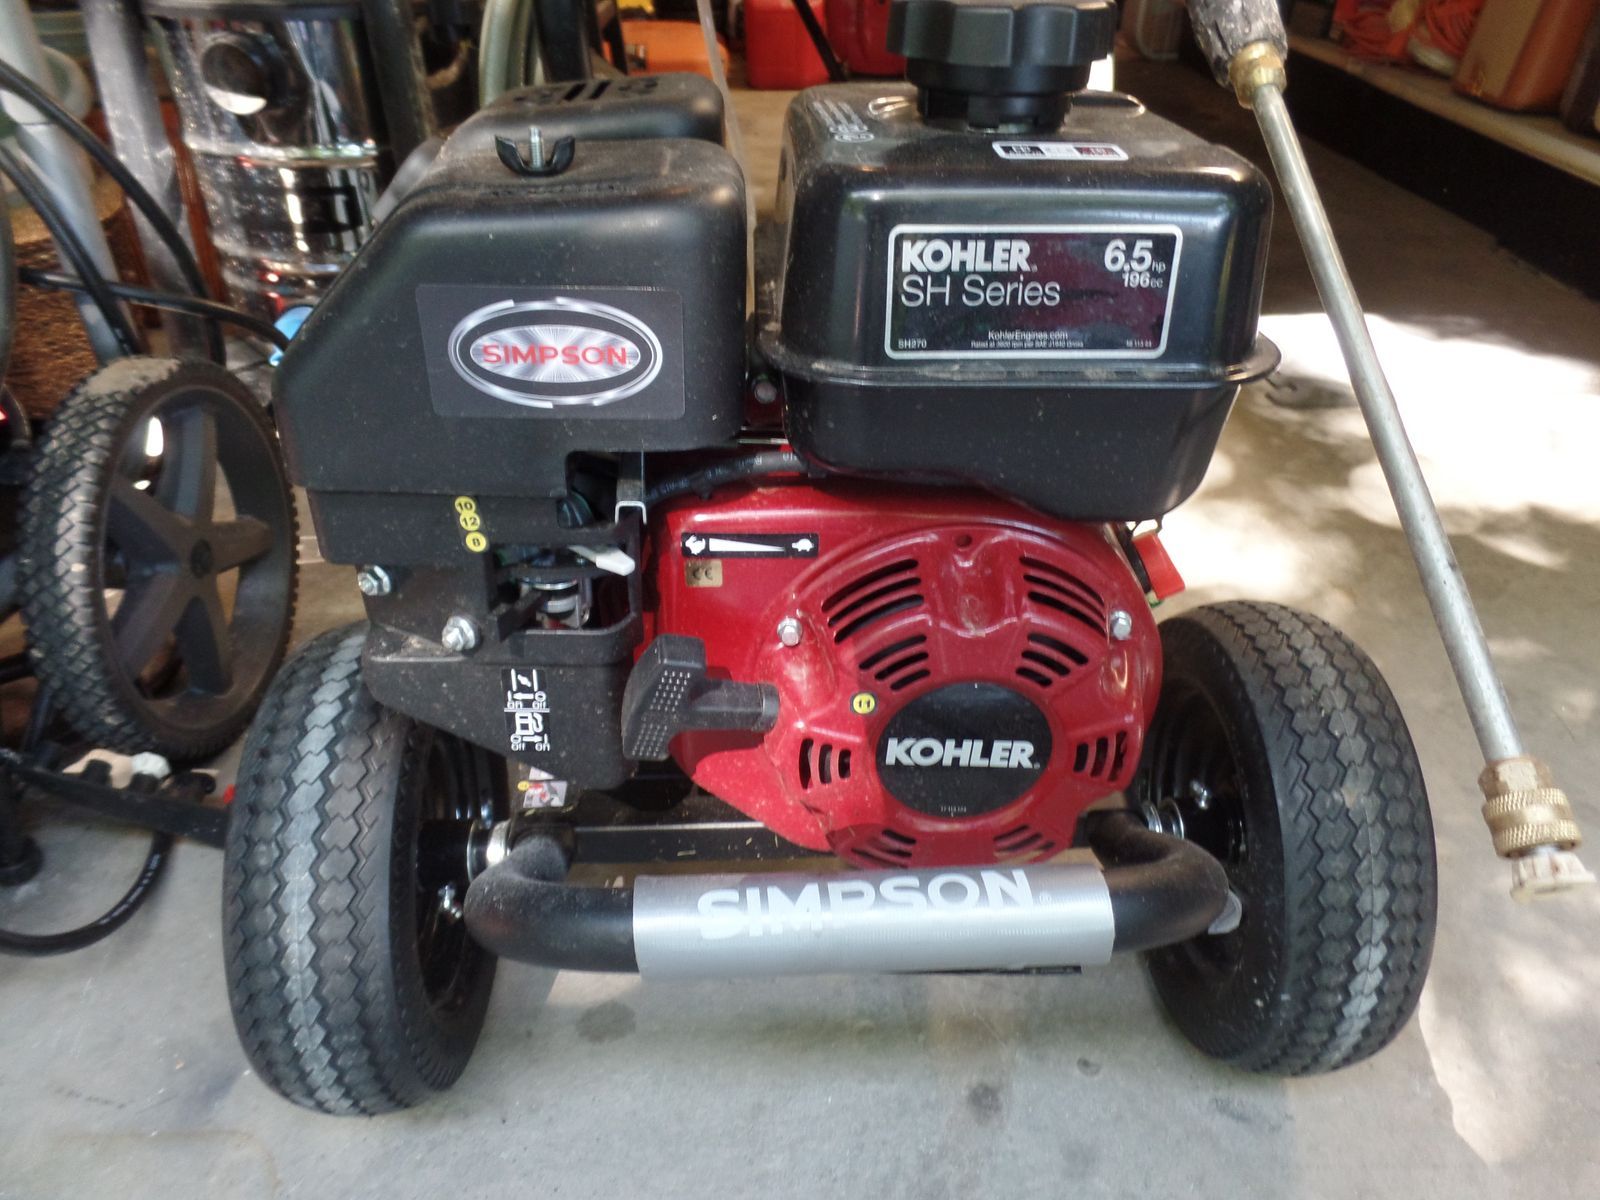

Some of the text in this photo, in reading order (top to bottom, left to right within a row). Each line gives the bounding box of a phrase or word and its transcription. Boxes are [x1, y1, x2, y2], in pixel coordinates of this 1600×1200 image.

[901, 238, 1031, 273] KOHLER
[901, 273, 1061, 307] SH Series
[482, 344, 627, 366] SIMPSON
[457, 501, 474, 511] 10
[462, 517, 479, 527] 12
[885, 737, 1035, 769] KOHLER
[697, 868, 1034, 940] SIMPSON
